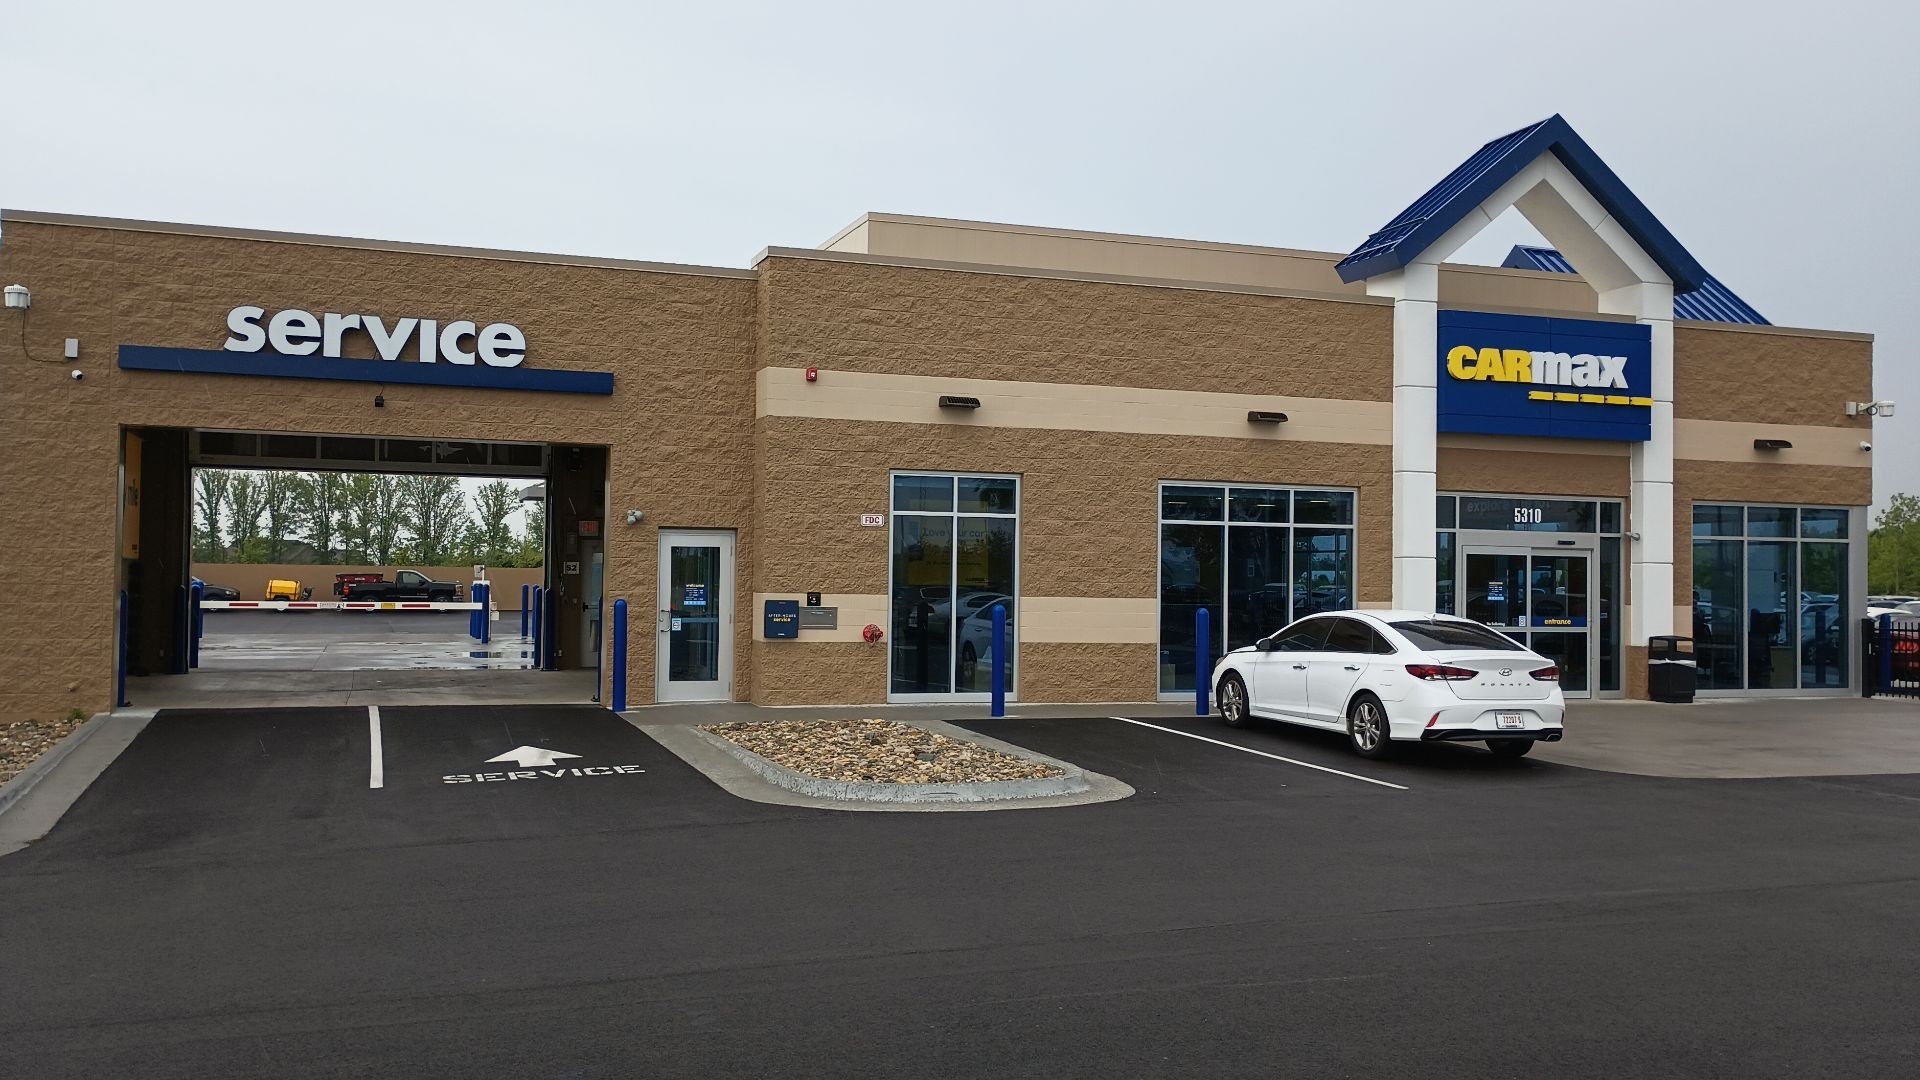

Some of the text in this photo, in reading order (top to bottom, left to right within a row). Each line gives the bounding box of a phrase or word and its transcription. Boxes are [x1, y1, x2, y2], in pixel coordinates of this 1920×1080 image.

[223, 305, 526, 367] service
[1446, 345, 1628, 389] CARmax
[865, 516, 880, 524] FDC
[1514, 507, 1541, 523] 5310
[442, 764, 646, 784] SERVICE
